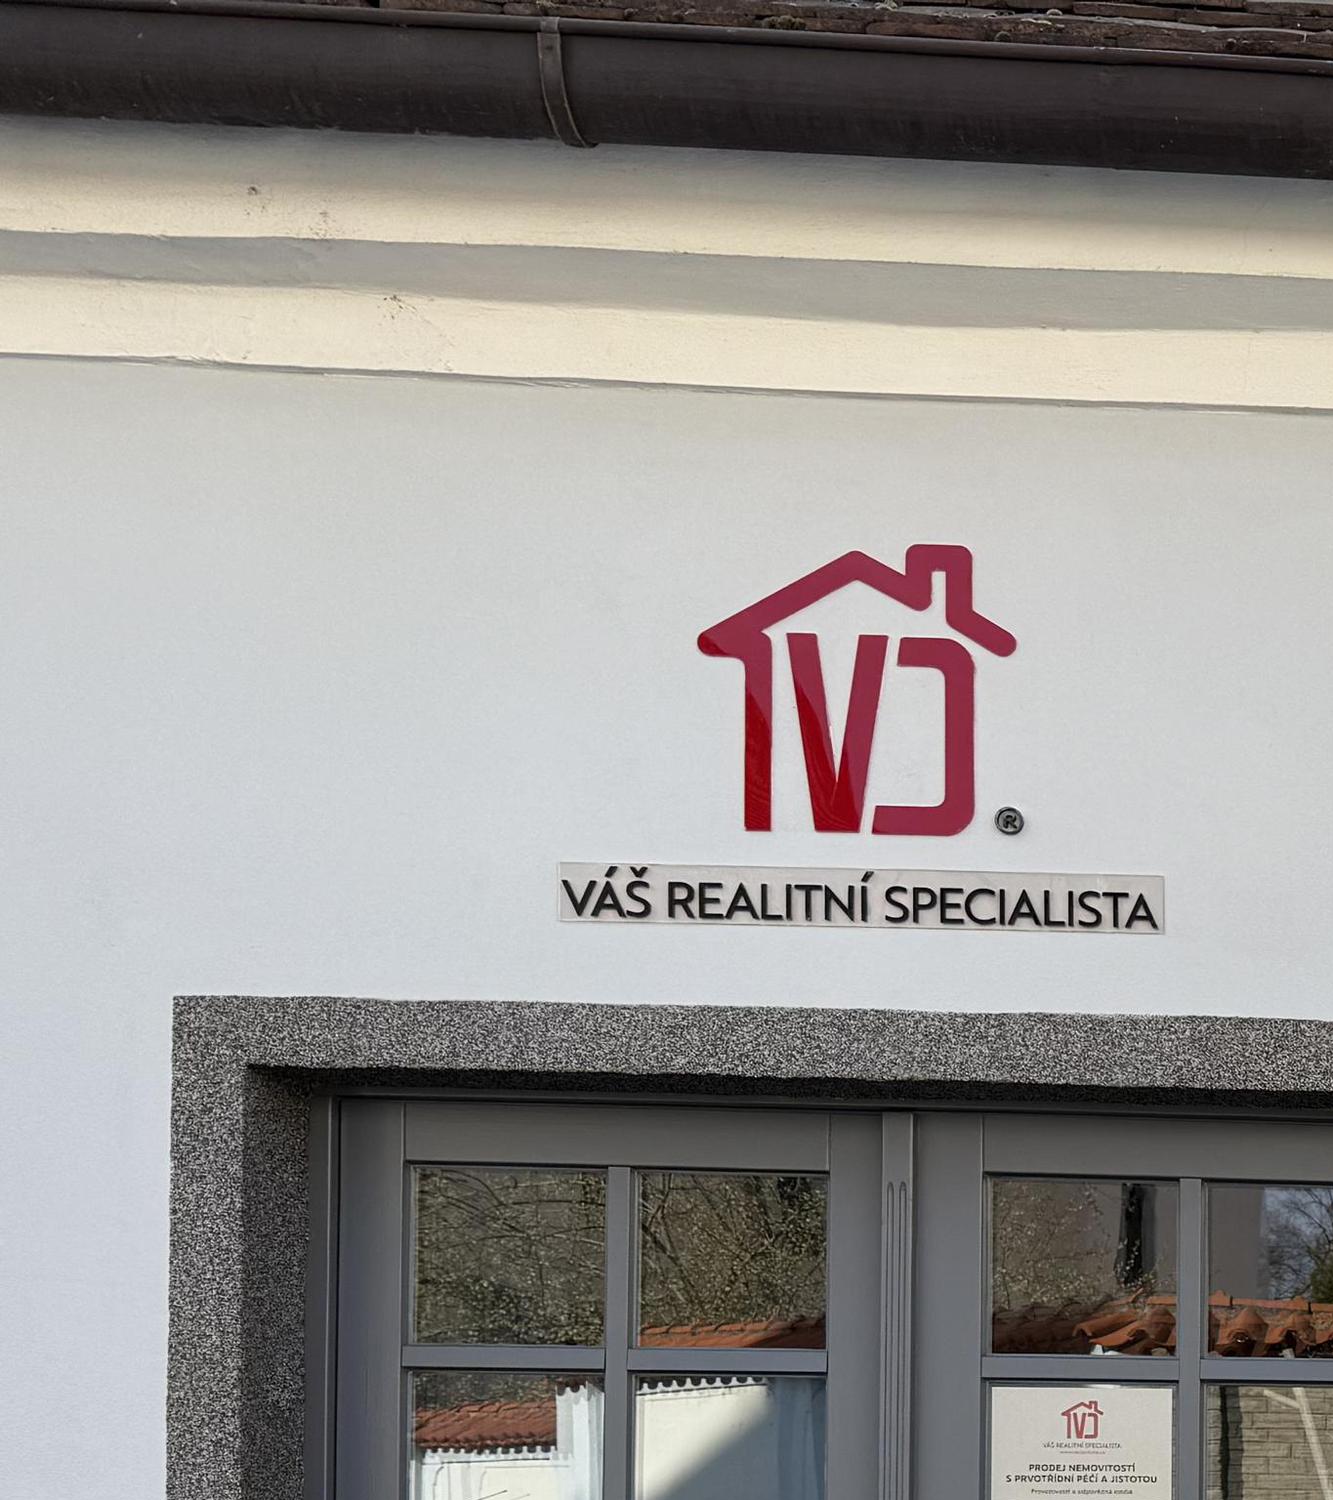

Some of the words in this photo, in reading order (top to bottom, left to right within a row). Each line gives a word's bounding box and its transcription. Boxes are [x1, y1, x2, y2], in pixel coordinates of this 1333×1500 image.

[561, 866, 651, 918] VÁŠ
[667, 871, 873, 922] REALITNÍ
[885, 885, 1159, 929] SPECIALISTA
[1029, 1464, 1066, 1472] PRODEJ
[1068, 1462, 1135, 1473] NEMOVITOSTÍ
[1006, 1475, 1012, 1483] S
[1015, 1473, 1074, 1483] PRVOTŘÍDNÍ
[1077, 1473, 1098, 1483] PÉČÍ
[1101, 1475, 1108, 1483] A
[1111, 1475, 1157, 1483] JISTOTOU
